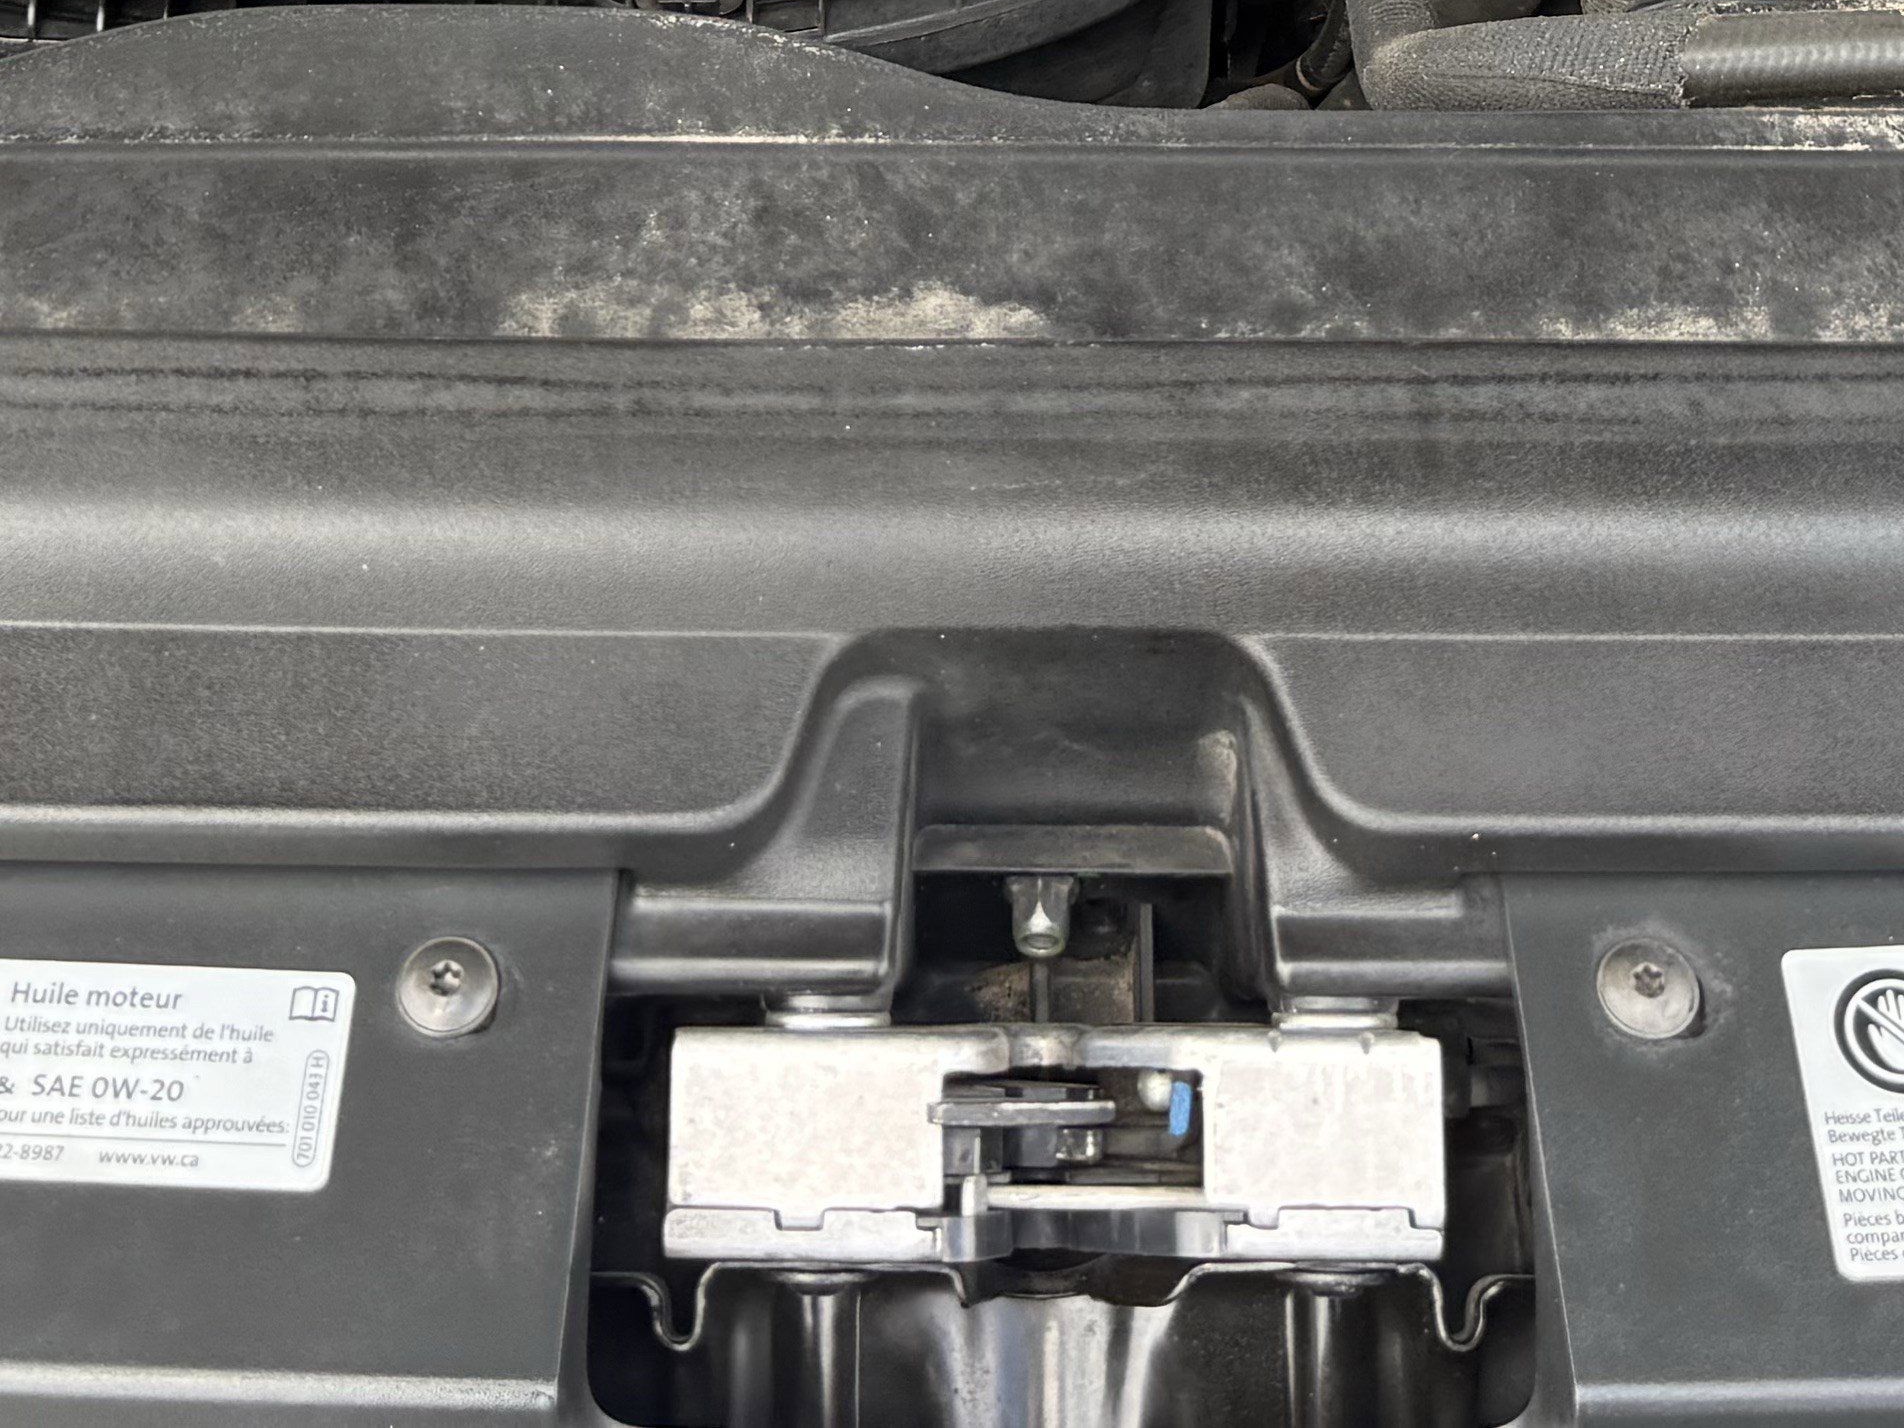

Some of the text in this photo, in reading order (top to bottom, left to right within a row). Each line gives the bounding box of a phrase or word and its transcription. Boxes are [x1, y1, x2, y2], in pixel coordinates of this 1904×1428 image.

[10, 981, 184, 1010] Huile moteur
[4, 1015, 275, 1043] Utilisez uniquement de l'huile
[32, 1039, 106, 1059] satisfait
[109, 1044, 238, 1065] expressément
[242, 1046, 254, 1065] à
[31, 1073, 84, 1098] SAE
[91, 1076, 185, 1103] 0W-20
[30, 1110, 66, 1125] une
[68, 1107, 107, 1127] liste
[108, 1109, 178, 1130] d'huiles
[181, 1115, 290, 1136] approuvées:
[1823, 1111, 1872, 1126] Heisse
[1826, 1127, 1897, 1146] Bewegte
[98, 1151, 200, 1168] www.vw.ca
[1831, 1151, 1865, 1167] HOT
[1835, 1167, 1897, 1185] ENGINE
[1842, 1212, 1893, 1228] Pièces
[1849, 1243, 1899, 1262] Pièces
